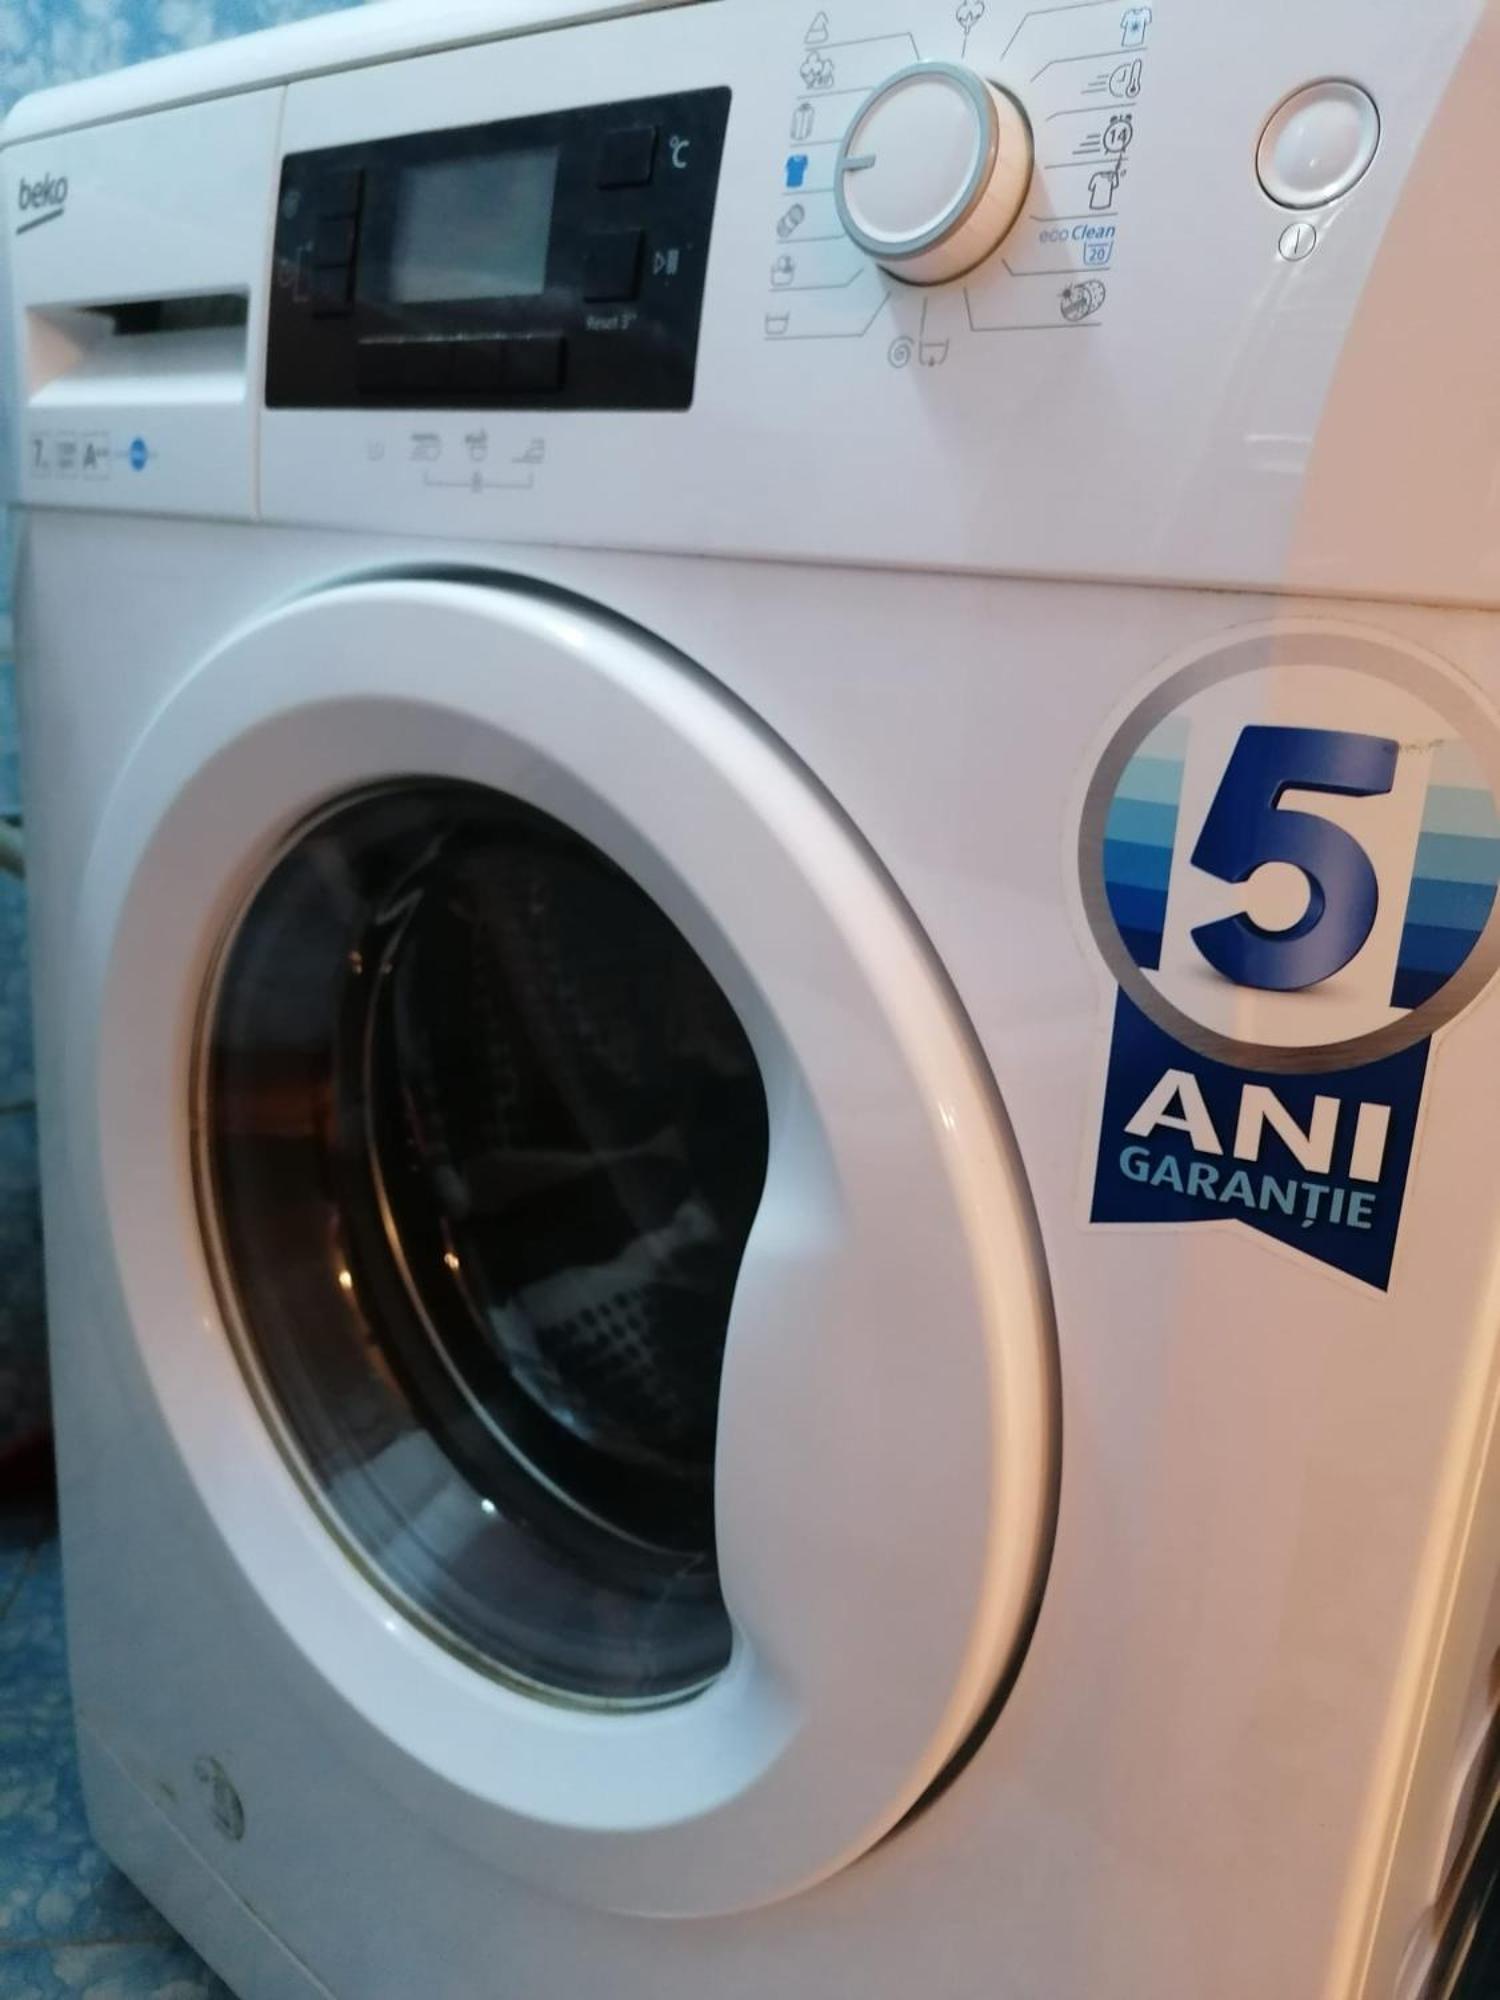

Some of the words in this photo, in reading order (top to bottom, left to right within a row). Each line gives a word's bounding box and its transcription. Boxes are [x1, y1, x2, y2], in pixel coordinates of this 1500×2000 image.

[18, 172, 68, 210] beko
[1039, 226, 1070, 244] eco
[1071, 223, 1116, 241] Clean
[1088, 248, 1106, 262] 20
[1189, 724, 1399, 993] 5
[1123, 1067, 1392, 1183] ANI
[1118, 1145, 1377, 1230] GARANȚIE
